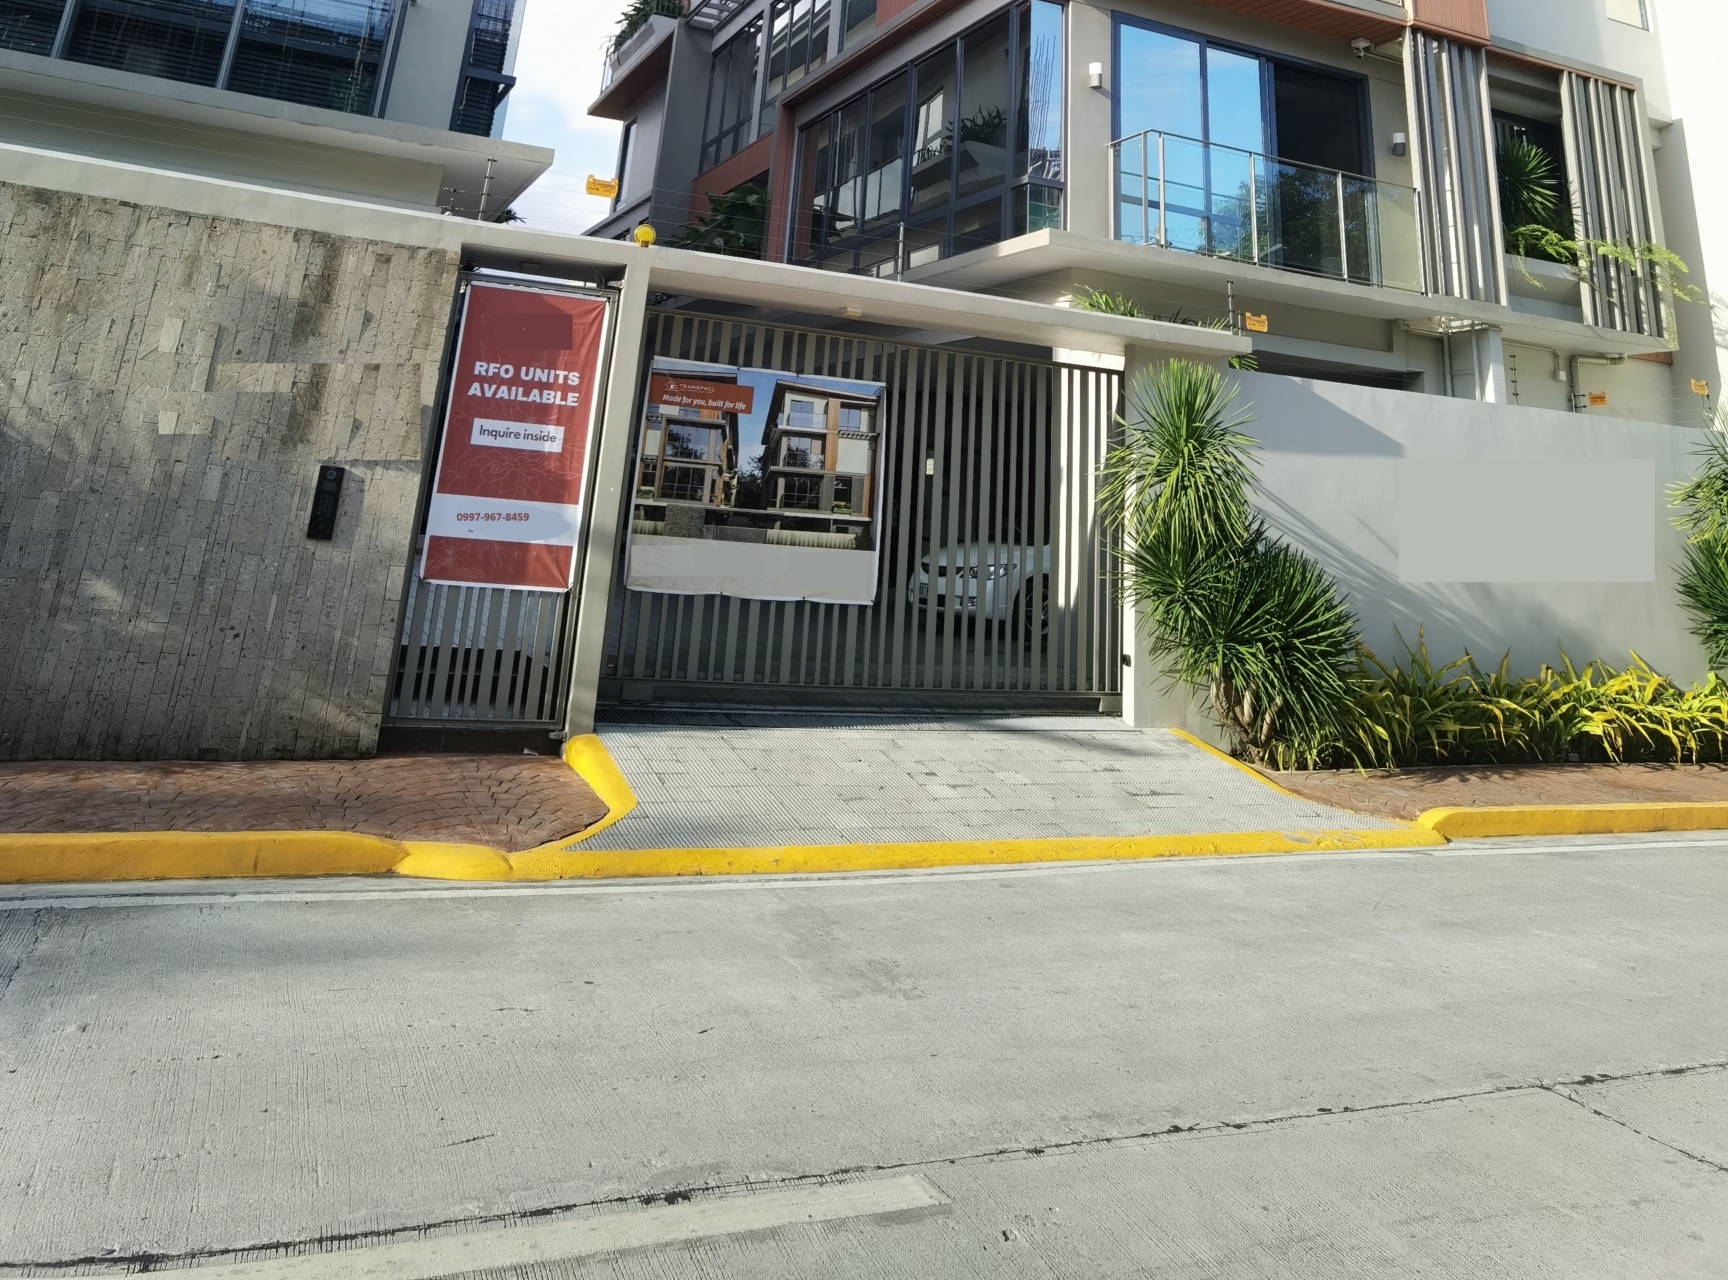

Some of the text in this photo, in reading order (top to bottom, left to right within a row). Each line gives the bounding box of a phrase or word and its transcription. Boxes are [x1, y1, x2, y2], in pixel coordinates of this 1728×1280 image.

[474, 361, 580, 386] RFO UNITS
[467, 382, 580, 407] AVAILABLE
[679, 383, 715, 392] TRANSPHIL
[662, 394, 747, 411] Made for you, built for life
[479, 424, 557, 443] Inquire inside
[456, 513, 530, 522] 0997-967-8459
